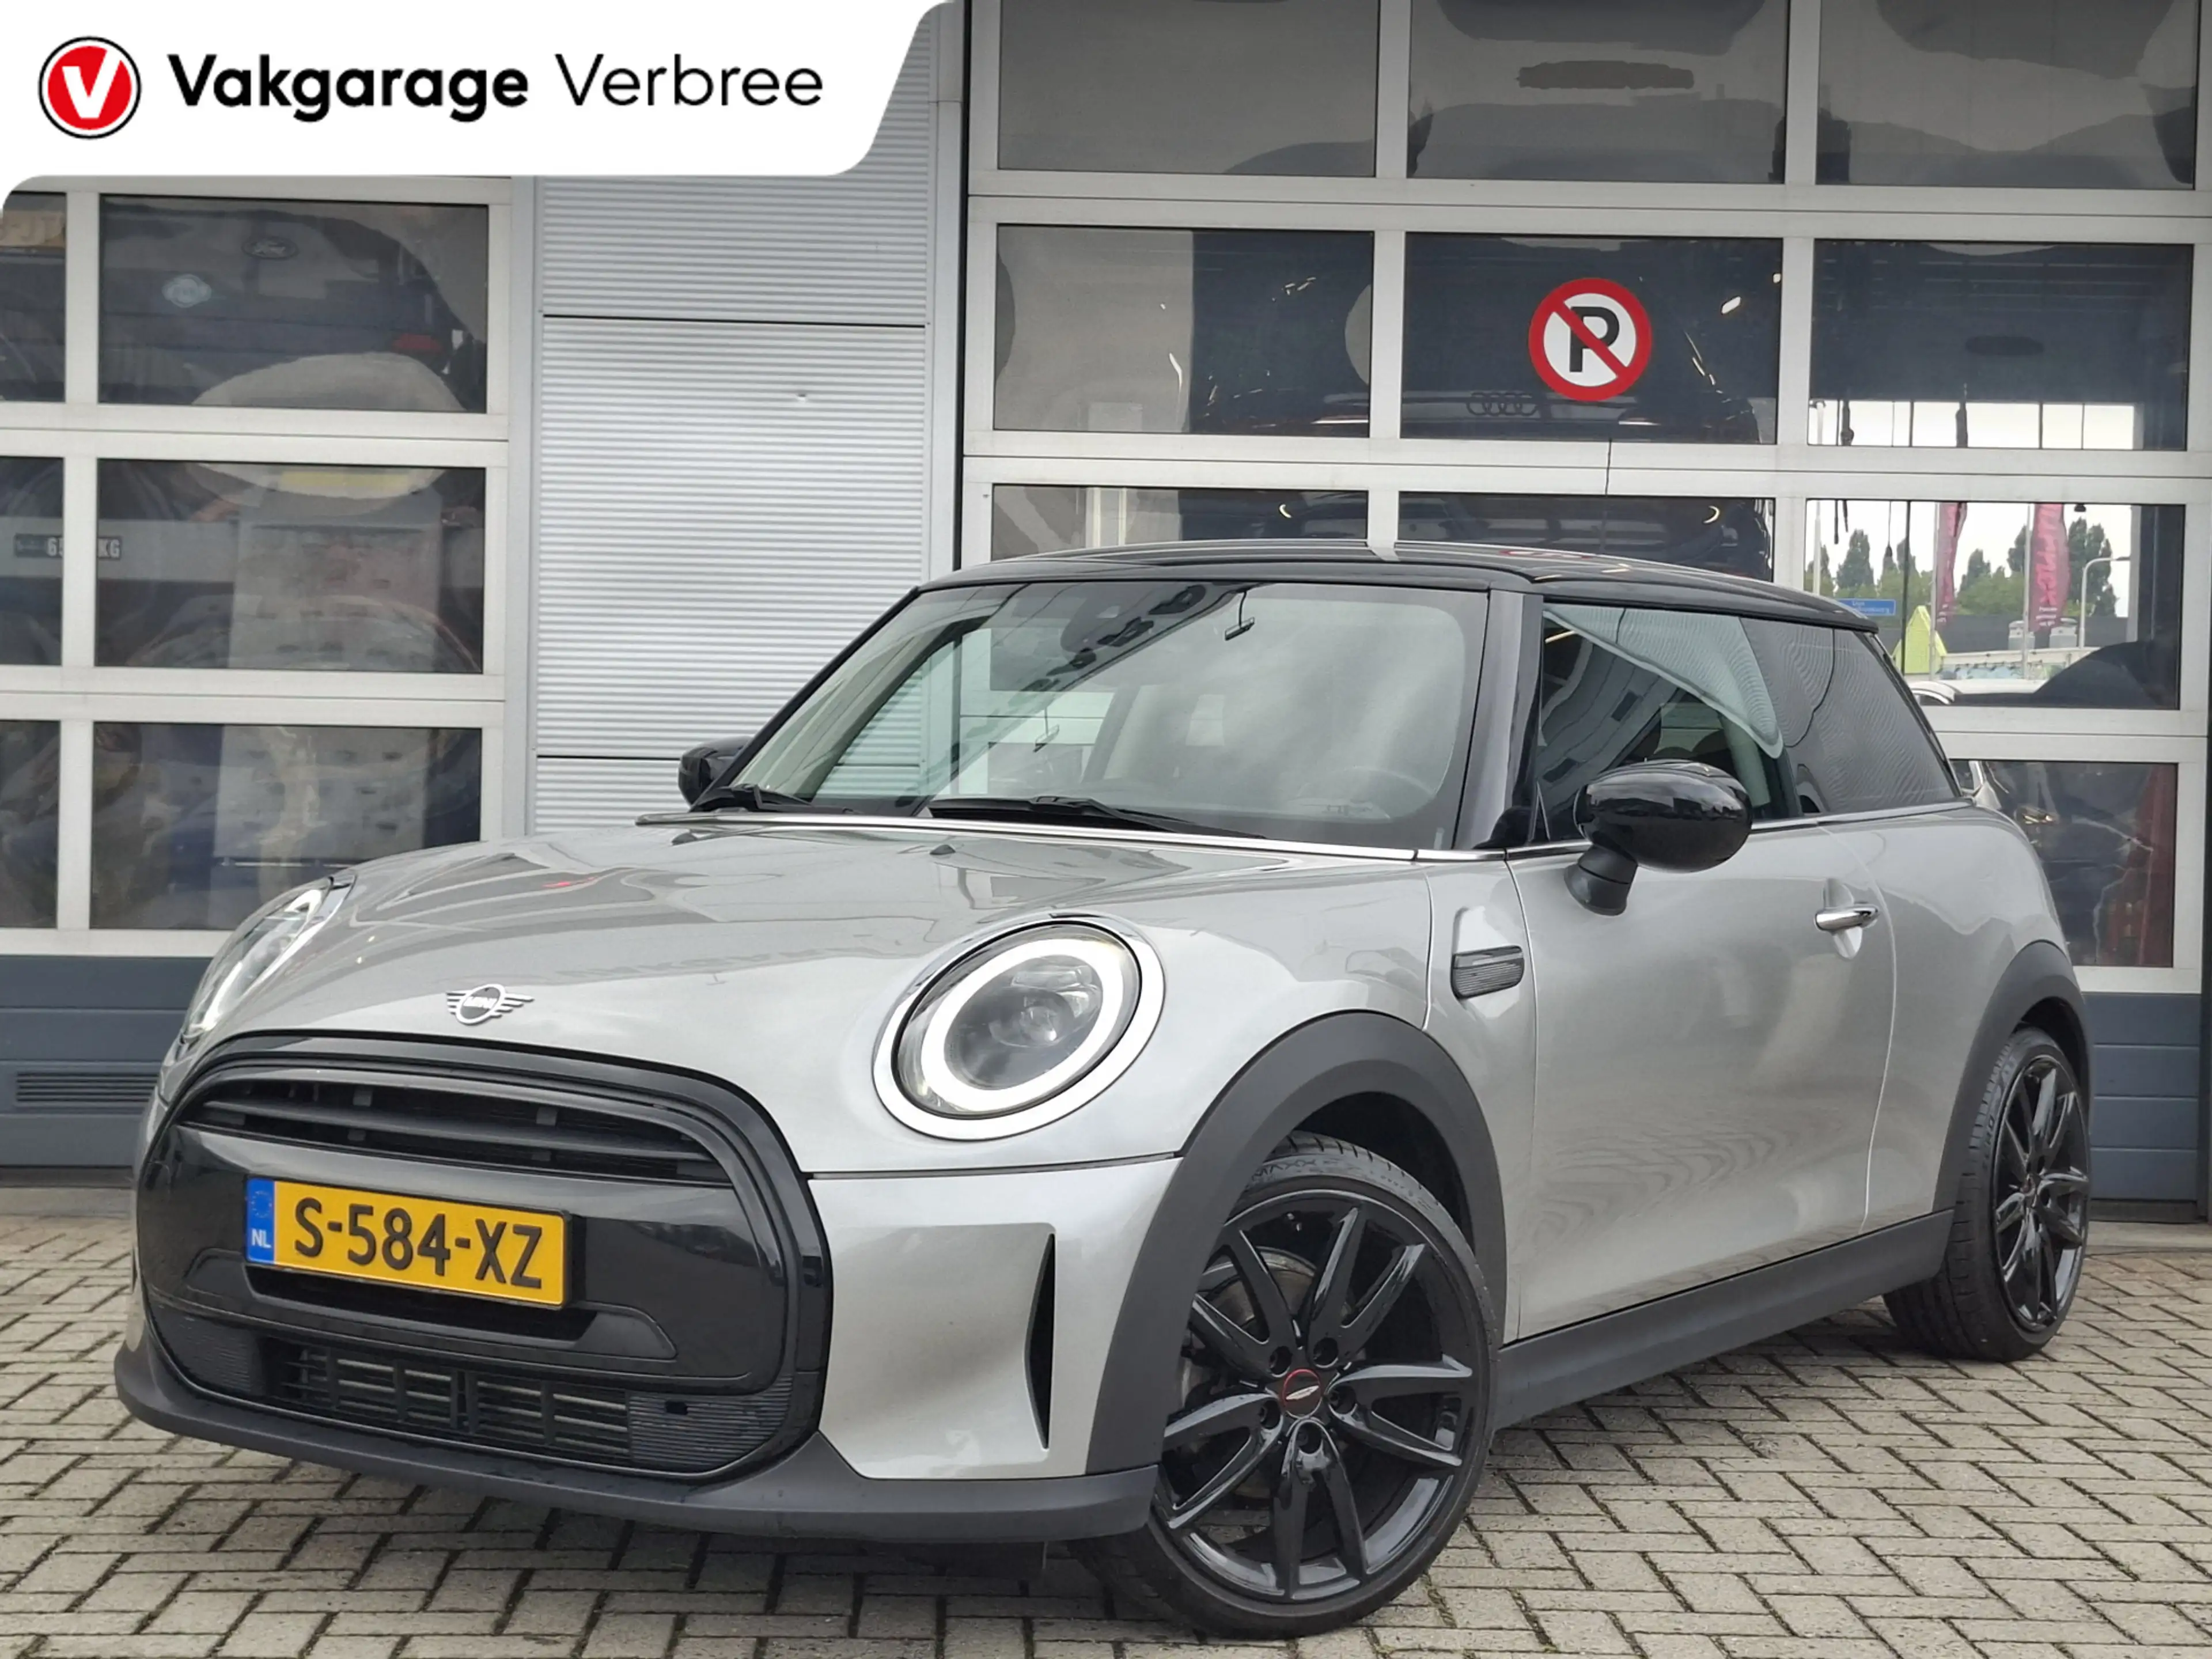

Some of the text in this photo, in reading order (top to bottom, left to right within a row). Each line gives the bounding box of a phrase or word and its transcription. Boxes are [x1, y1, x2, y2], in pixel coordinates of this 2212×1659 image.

[1569, 306, 1620, 372] P
[251, 1228, 272, 1249] NL
[294, 1196, 542, 1289] S-584-XZ
